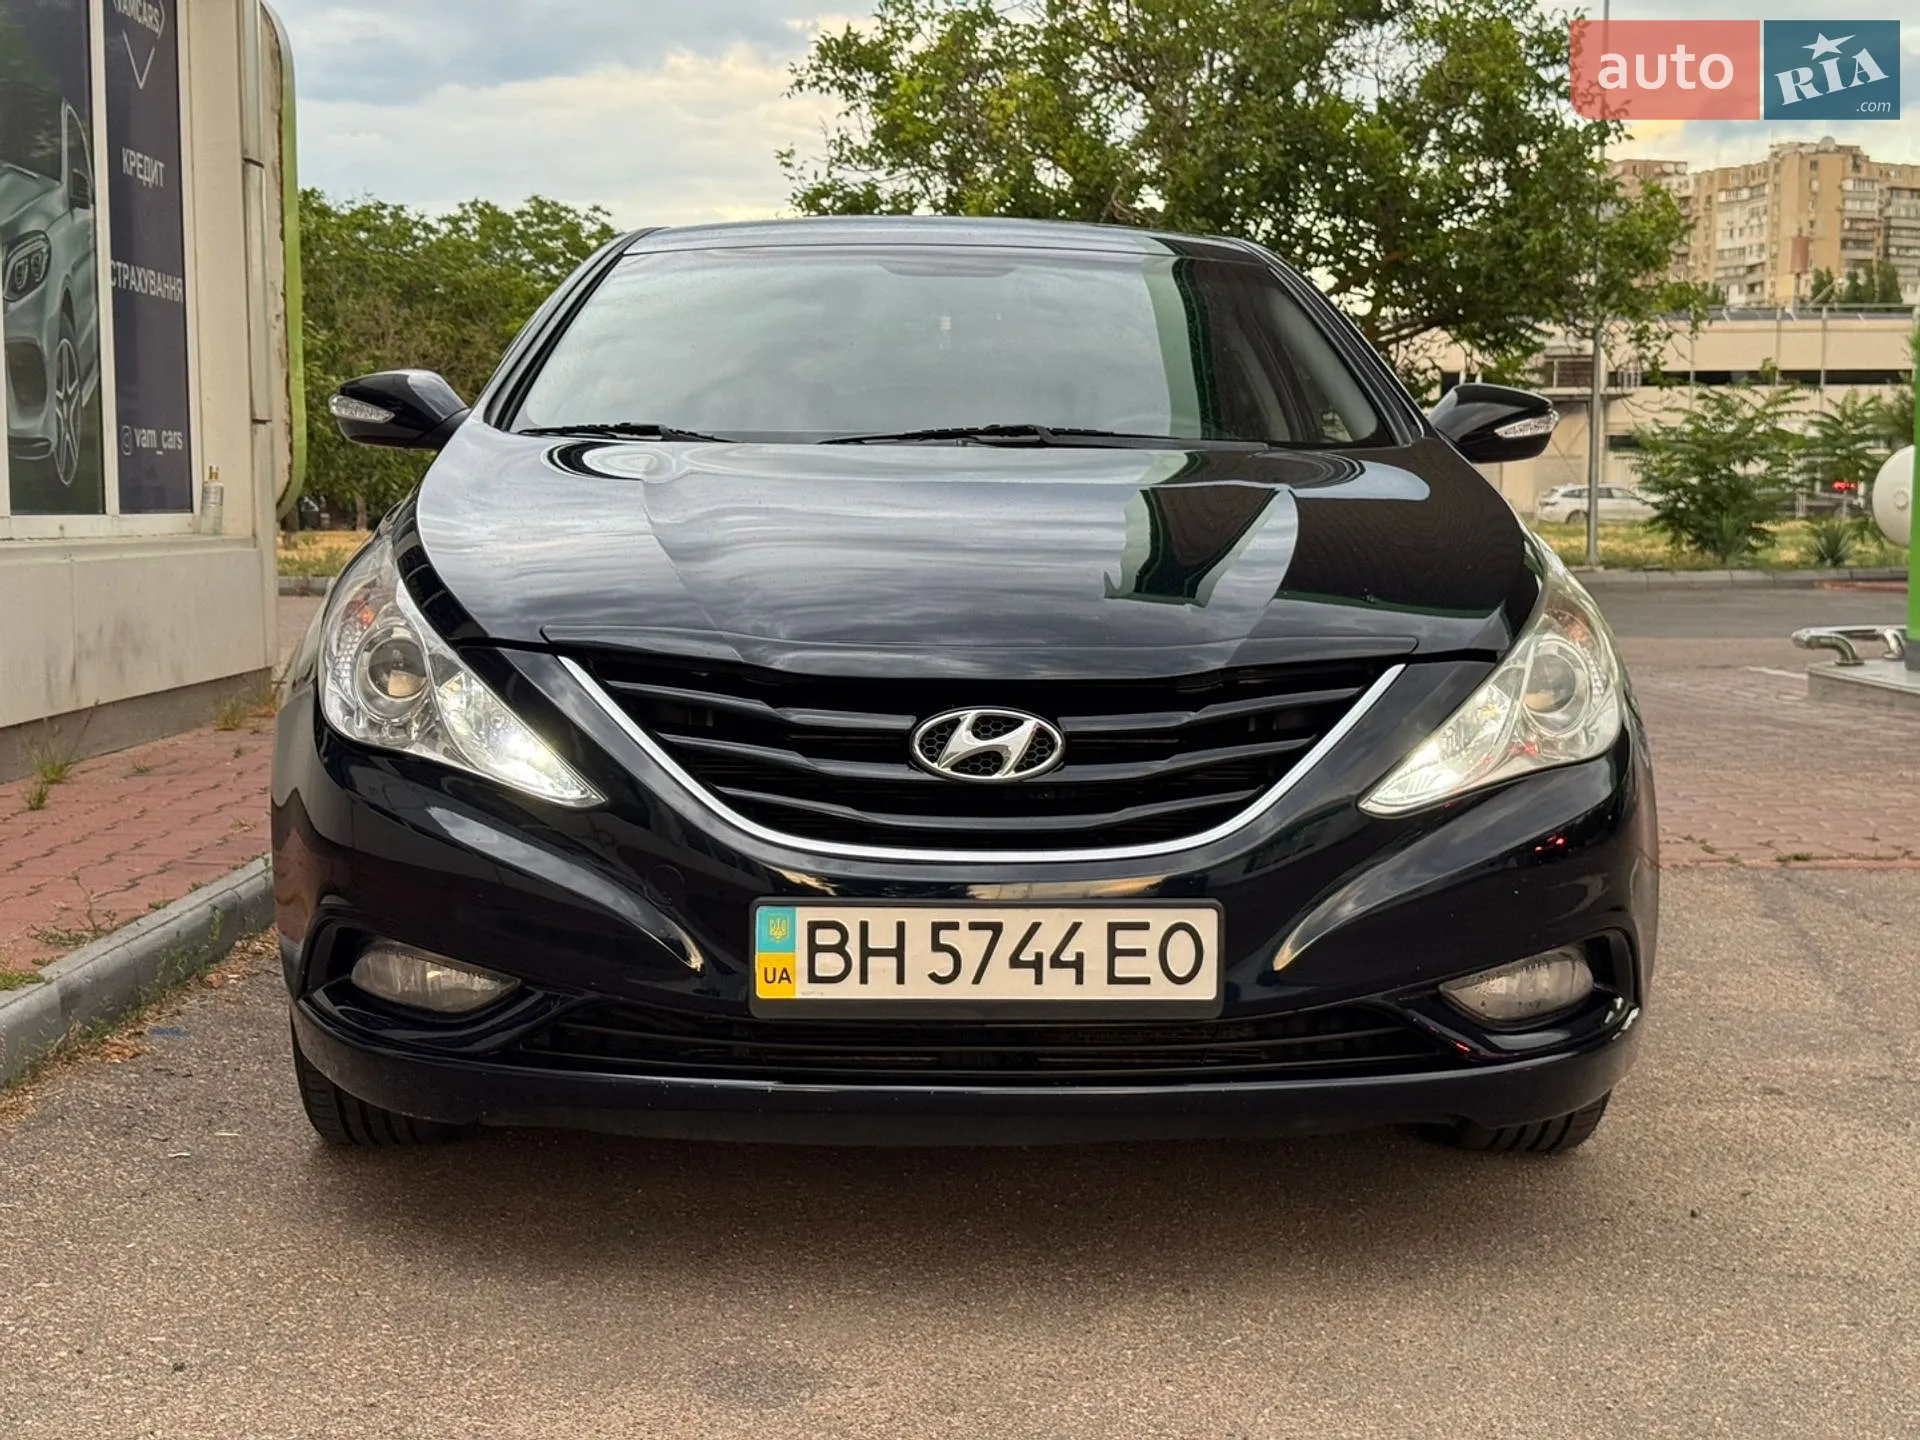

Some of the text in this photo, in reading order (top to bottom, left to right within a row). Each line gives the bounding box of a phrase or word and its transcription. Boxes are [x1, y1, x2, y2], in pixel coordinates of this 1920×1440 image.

[121, 146, 165, 189] КРЕДИТ
[110, 259, 183, 303] СТРАХУВАННЯ
[133, 427, 183, 455] vam_cars
[807, 919, 1205, 986] BH 5744 EO
[763, 967, 792, 985] UA
